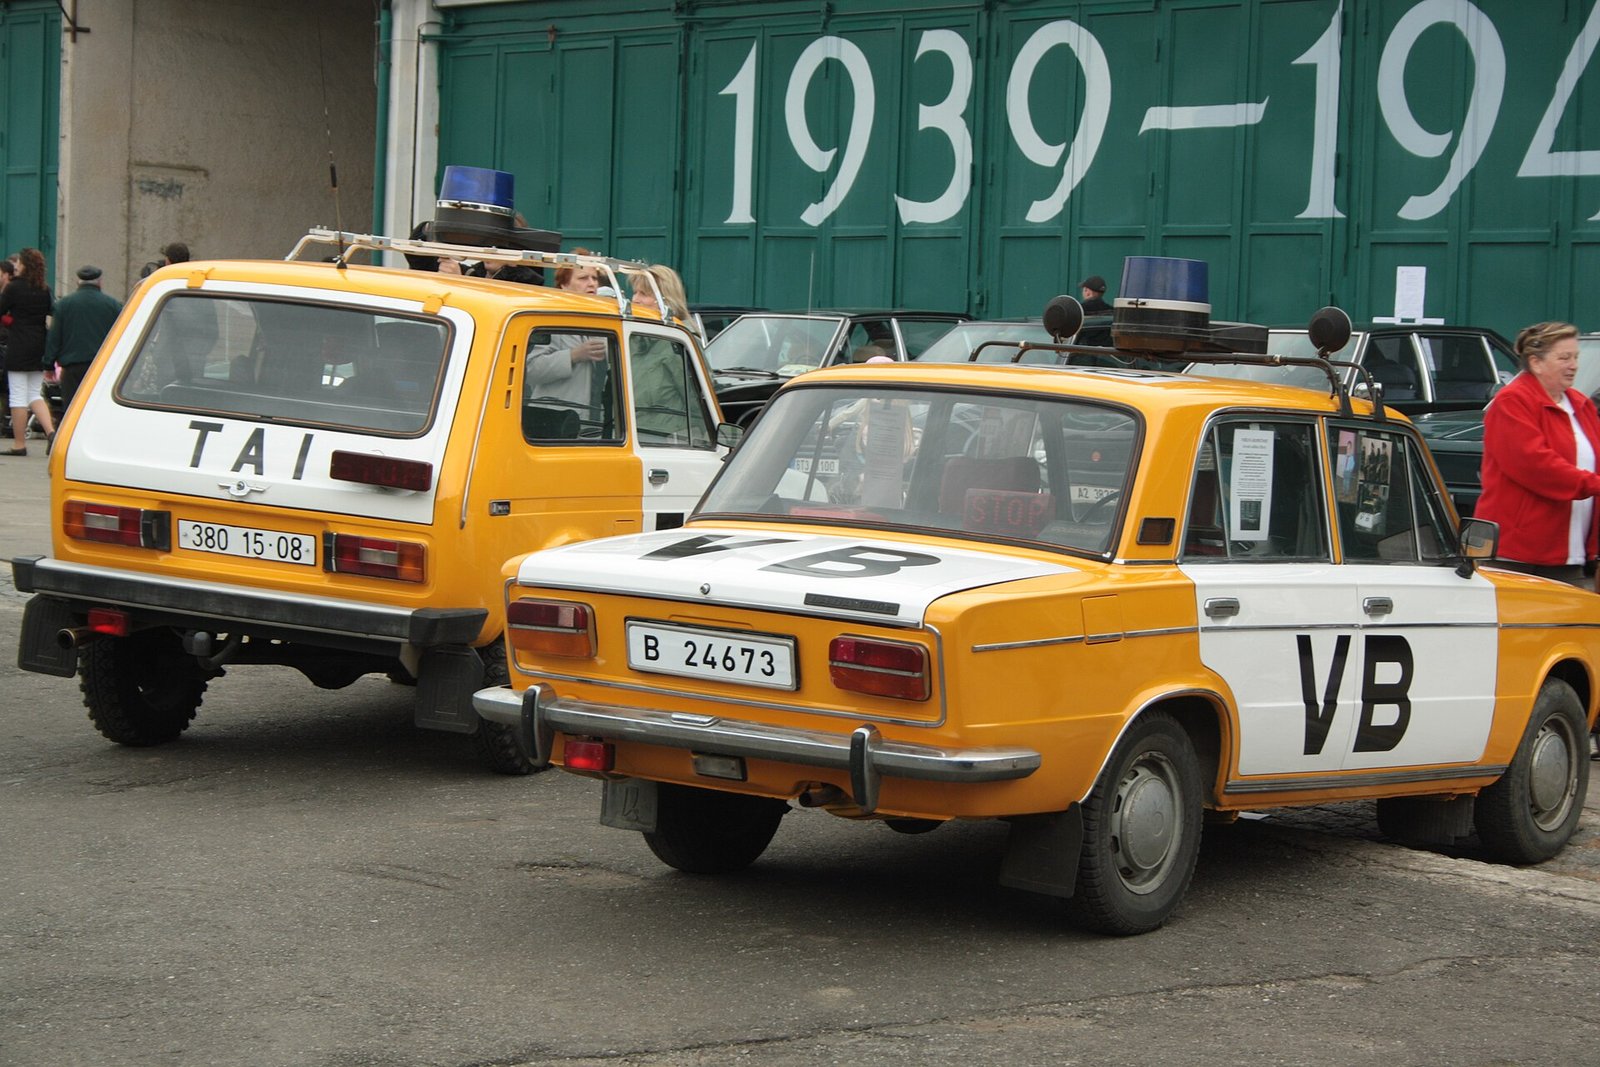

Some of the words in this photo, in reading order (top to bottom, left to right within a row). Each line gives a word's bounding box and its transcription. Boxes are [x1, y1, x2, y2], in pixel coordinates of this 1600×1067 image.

[188, 420, 315, 481] TAI
[971, 494, 1046, 528] STOP
[191, 524, 229, 551] 380
[638, 534, 942, 579] VB
[643, 634, 660, 661] B
[684, 640, 775, 677] 24673
[1296, 634, 1414, 756] VB
